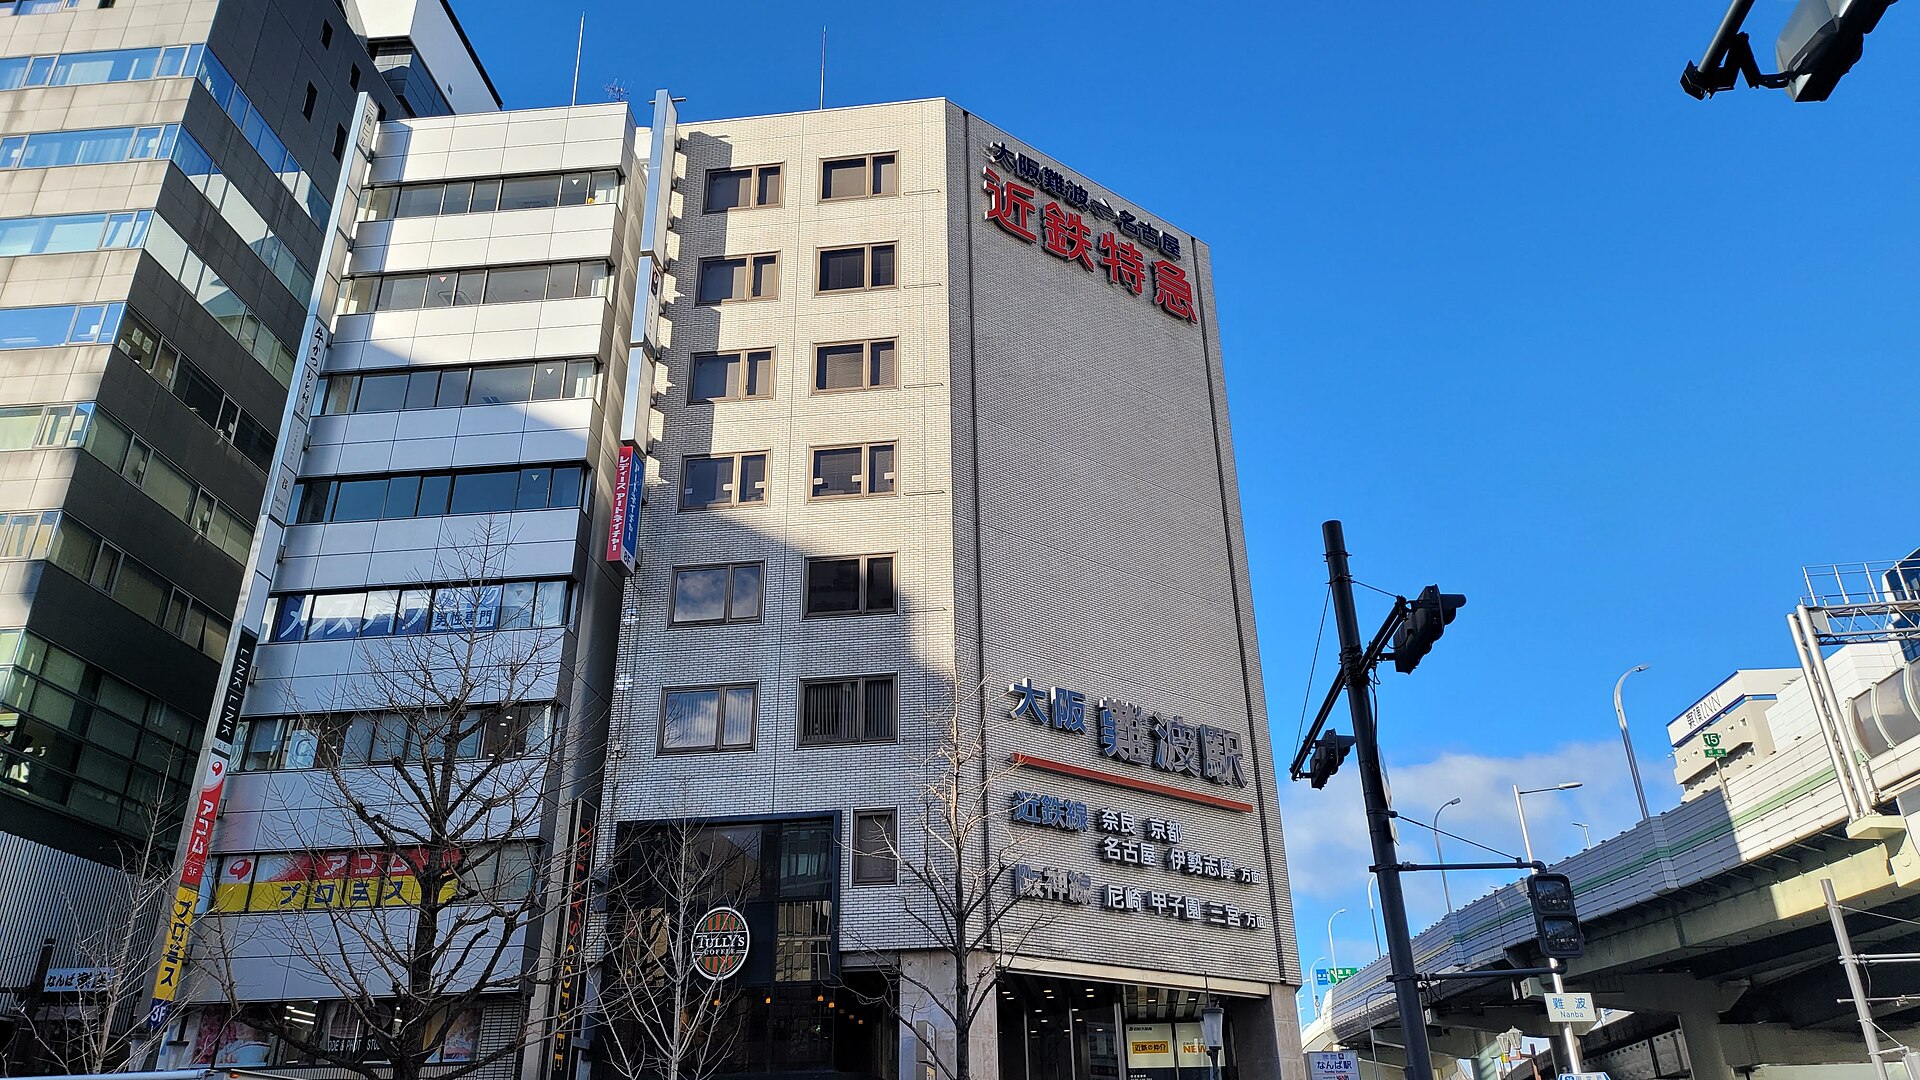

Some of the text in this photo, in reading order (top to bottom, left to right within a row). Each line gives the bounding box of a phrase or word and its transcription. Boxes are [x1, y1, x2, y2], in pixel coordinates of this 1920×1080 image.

[990, 142, 1181, 259] 大阪難波 名古屋
[983, 165, 1198, 324] 近鉄特急
[221, 647, 250, 737] LINK LINK
[1009, 677, 1249, 788] 大阪 難波駅
[1704, 734, 1719, 745] 15
[192, 799, 214, 855] アコム
[1014, 790, 1183, 843] 近鉄線 奈良 京都
[323, 854, 411, 876] アコム
[1103, 836, 1262, 884] 名古屋 伊勢志摩 方面
[187, 866, 198, 877] 3F
[280, 881, 402, 905] プロミス
[1015, 863, 1267, 929] 阪神線 尼崎 甲子園 三宮 方面
[160, 900, 192, 987] プロミス
[695, 934, 745, 949] TULLY'S
[704, 948, 735, 956] COFFEE
[150, 1005, 167, 1022] 3F
[1552, 997, 1588, 1010] 難波
[1560, 1010, 1584, 1018] Nanba
[1134, 1043, 1166, 1052] 近鉄の仲介
[1183, 1045, 1207, 1054] NEW
[1316, 1060, 1353, 1070] なんば駅
